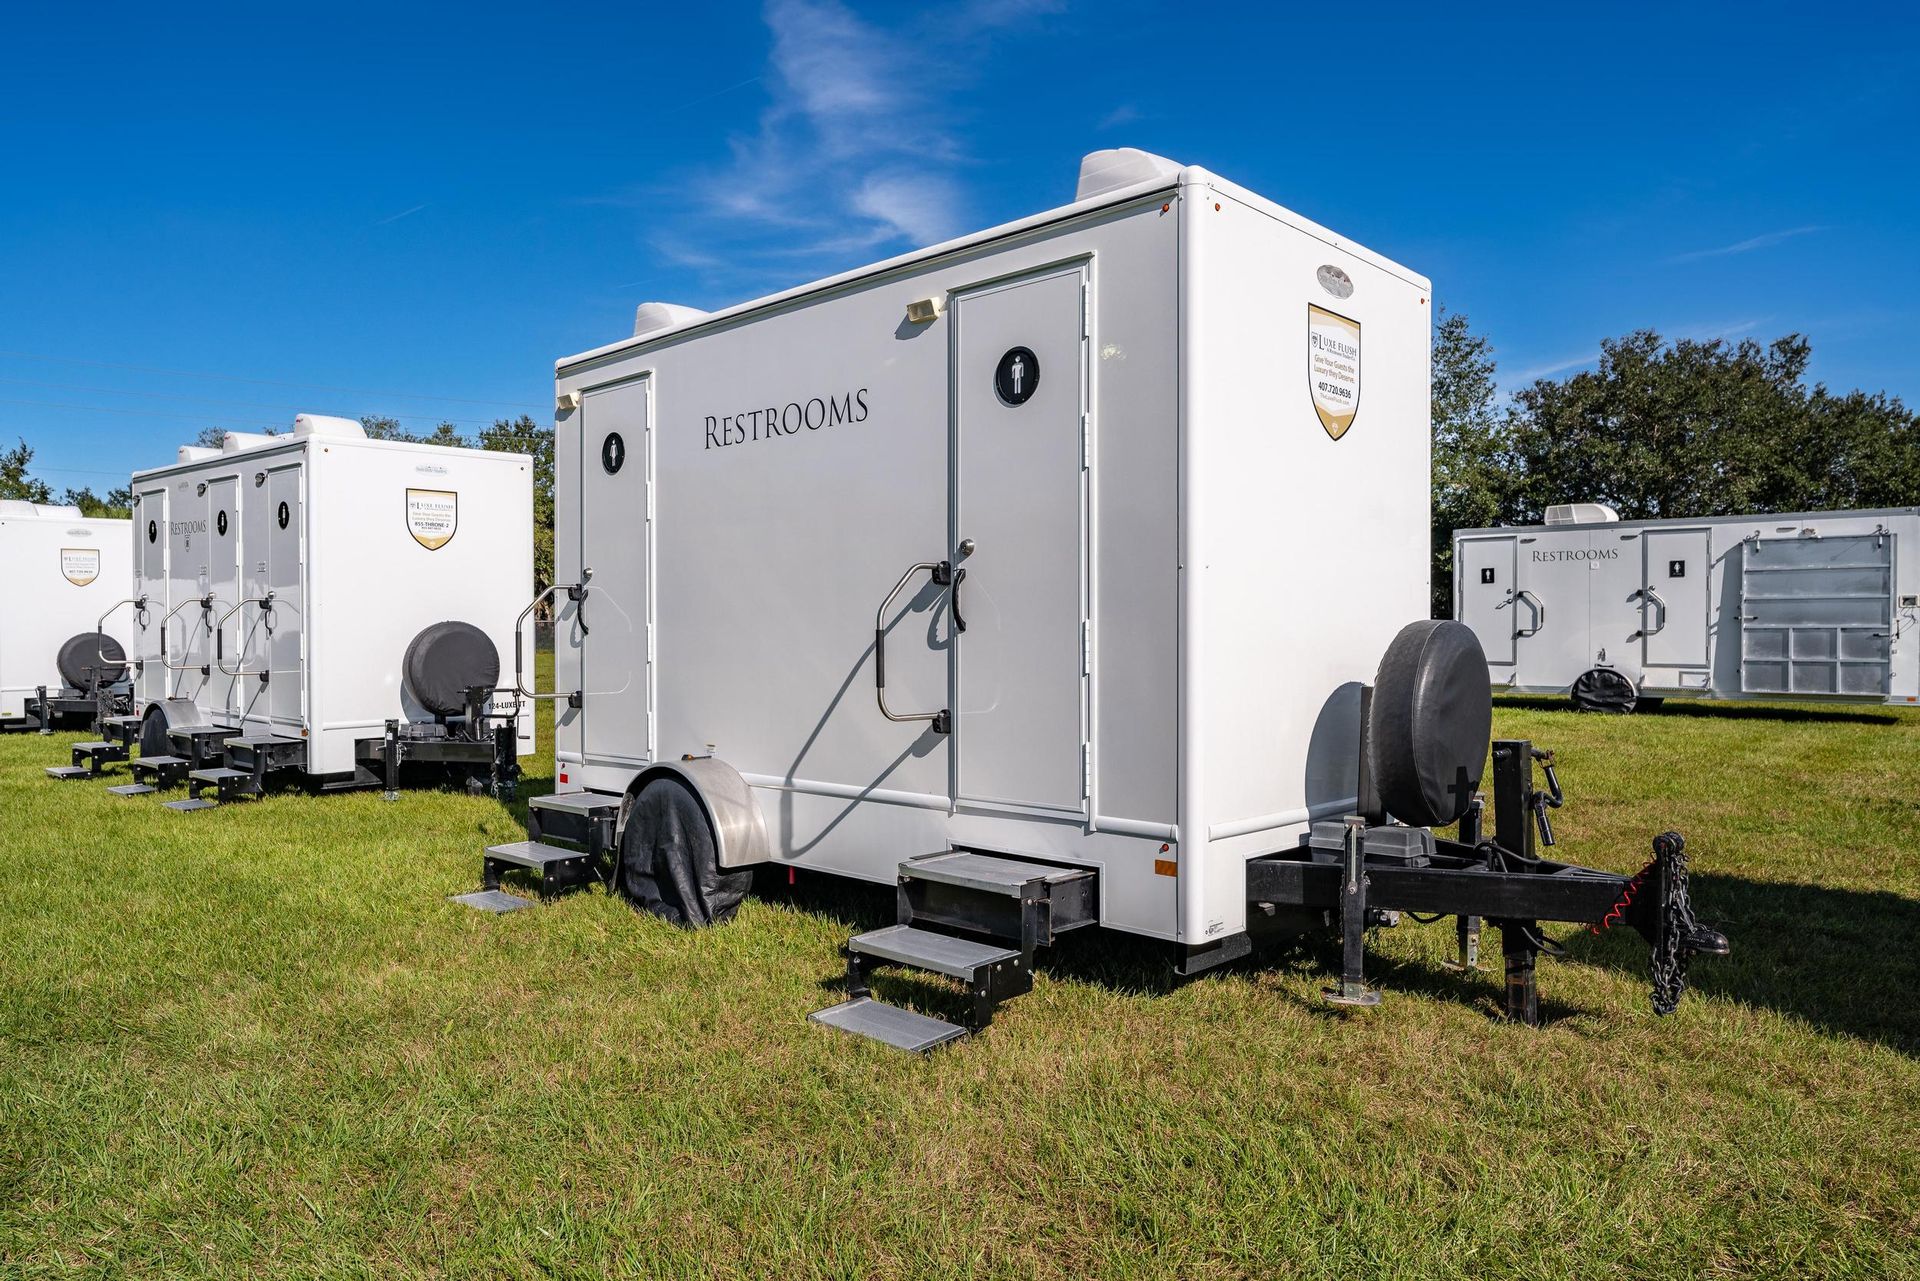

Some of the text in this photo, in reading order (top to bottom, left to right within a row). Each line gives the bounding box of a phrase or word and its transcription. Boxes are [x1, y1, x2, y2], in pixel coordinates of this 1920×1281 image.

[1319, 334, 1336, 350] LUXE
[1338, 342, 1357, 357] FLUSH
[1318, 381, 1352, 399] 407.720.9636
[704, 388, 868, 450] RESTROOMS
[170, 520, 207, 536] RESTROOMS
[1532, 548, 1618, 562] RESTROOMS
